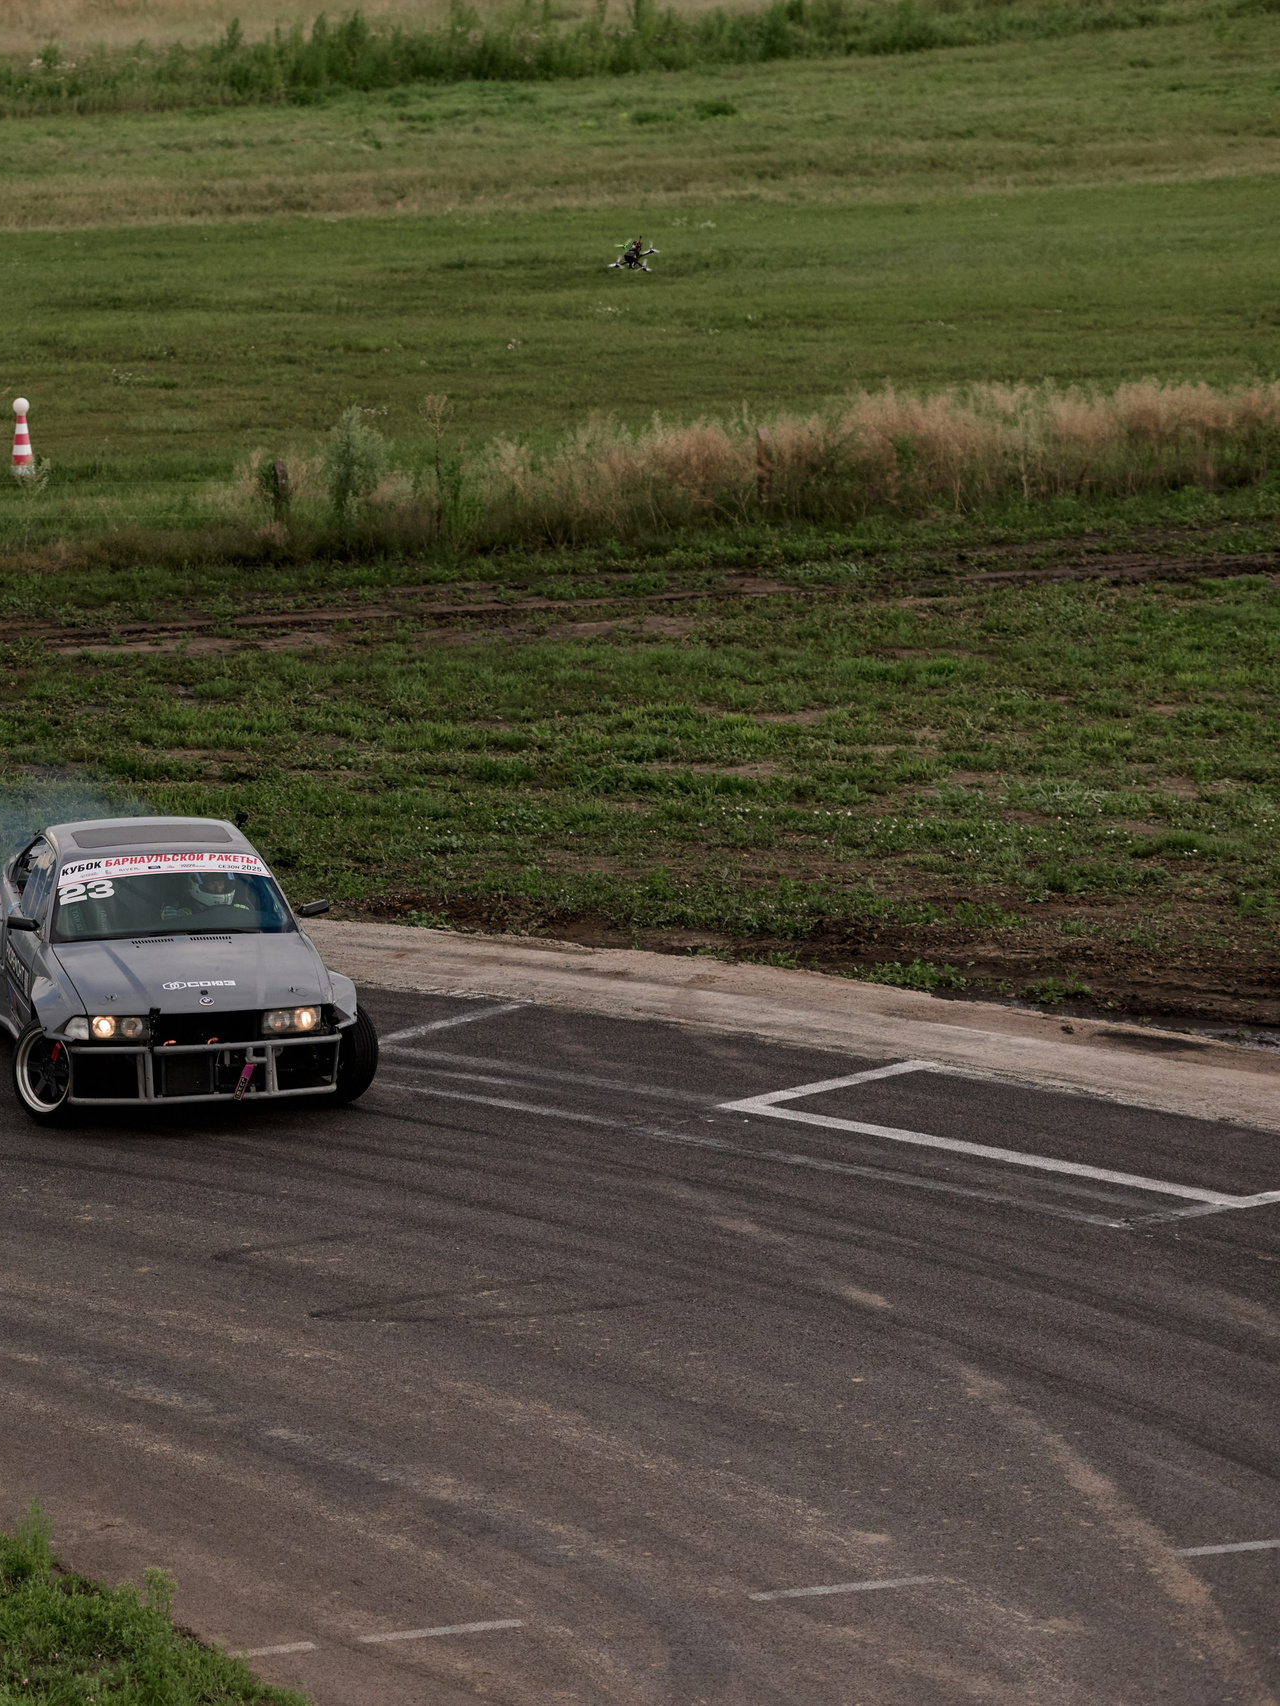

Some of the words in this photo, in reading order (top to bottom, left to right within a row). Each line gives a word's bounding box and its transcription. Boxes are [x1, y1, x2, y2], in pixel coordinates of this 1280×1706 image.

[61, 860, 103, 876] КУБОК
[105, 853, 205, 868] БАРНАУЛЬСКОЙ
[208, 853, 258, 865] РАКЕТЫ
[242, 864, 262, 872] 2025
[59, 879, 115, 906] 23
[186, 980, 236, 988] СОЮЗ
